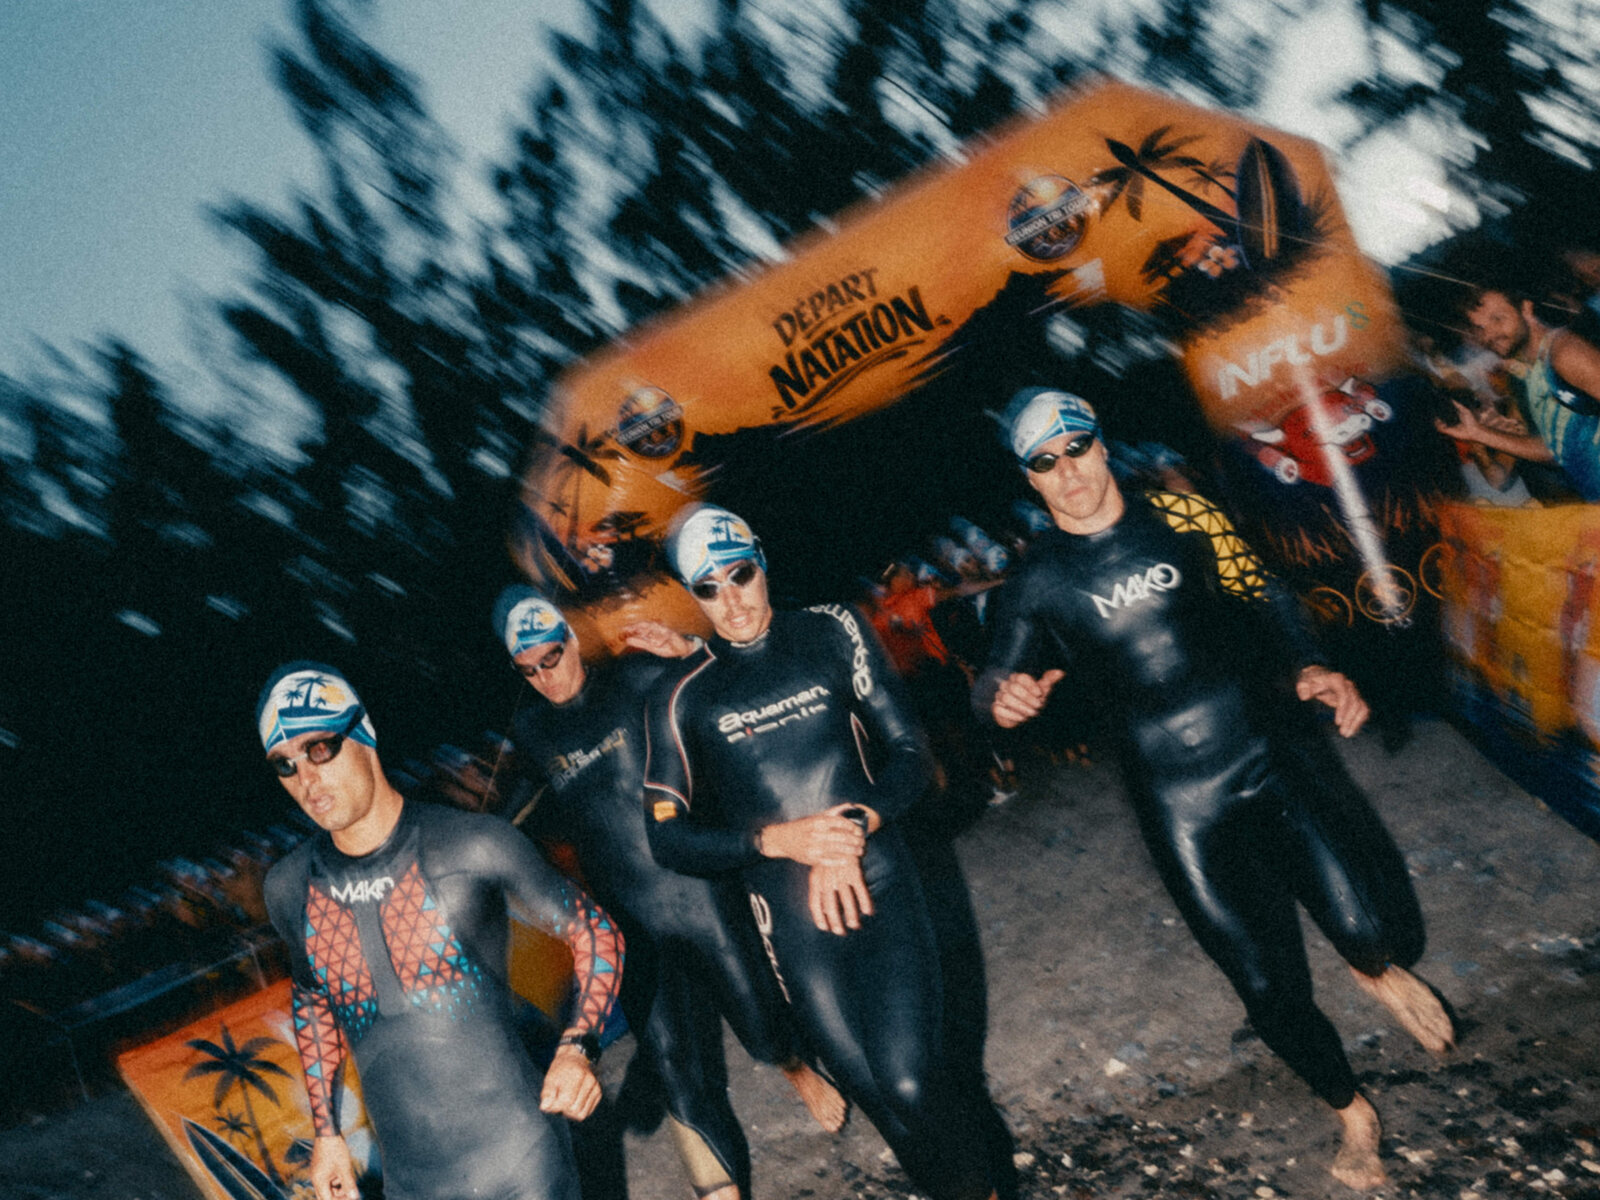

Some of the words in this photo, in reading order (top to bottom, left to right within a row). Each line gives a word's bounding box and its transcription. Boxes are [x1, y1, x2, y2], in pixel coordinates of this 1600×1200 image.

[769, 285, 934, 409] NATATION
[1091, 563, 1181, 619] MAKO
[718, 685, 831, 733] aquaman
